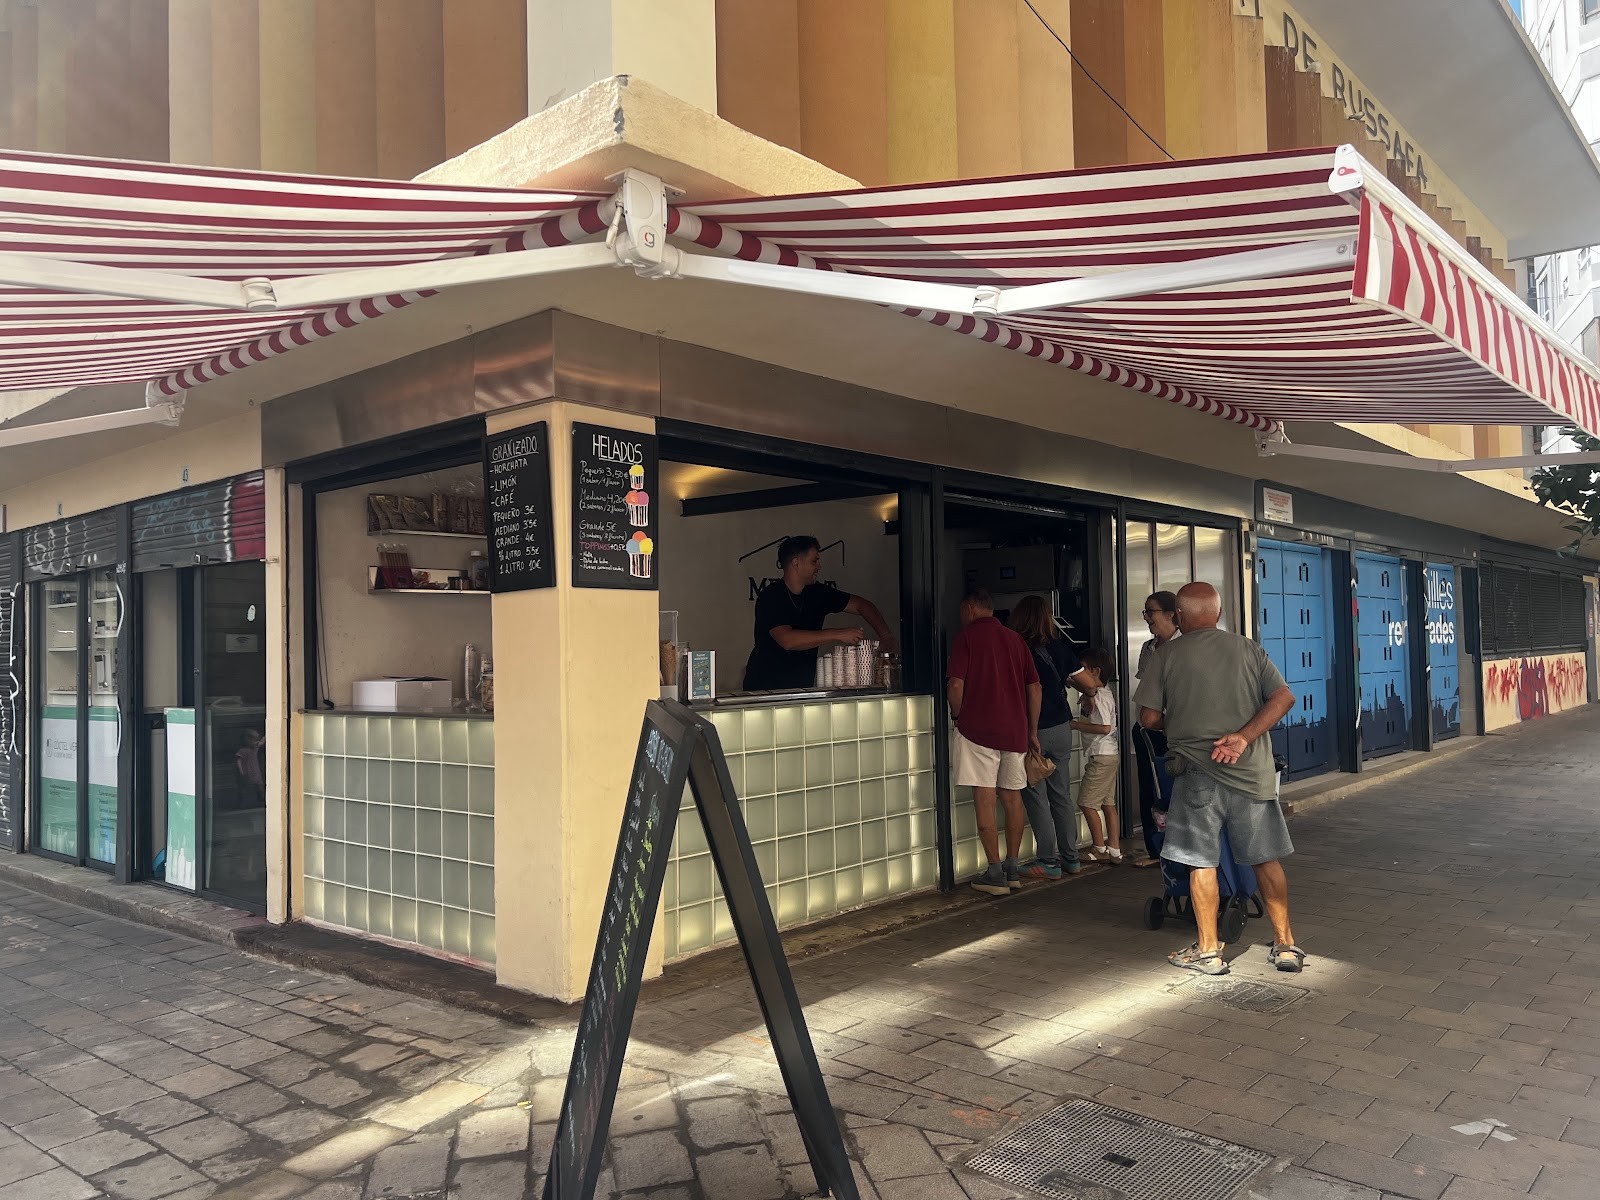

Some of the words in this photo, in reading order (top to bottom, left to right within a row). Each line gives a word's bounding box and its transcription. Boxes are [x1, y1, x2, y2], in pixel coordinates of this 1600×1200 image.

[1283, 11, 1317, 70] DE
[1332, 62, 1428, 190] RUSSAFA
[492, 436, 538, 461] GRANIZADO
[592, 433, 643, 464] HELADOS
[493, 507, 520, 523] PEQUEÑO
[524, 505, 535, 515] 3€
[494, 522, 520, 536] MEDIANO
[579, 519, 605, 531] Grande
[606, 521, 618, 532] 5€
[495, 534, 520, 549] GRANDE
[525, 532, 535, 542] 4€
[505, 550, 521, 560] LITRO
[499, 564, 504, 574] 1
[505, 561, 524, 574] LITRO
[529, 559, 541, 571] 10€
